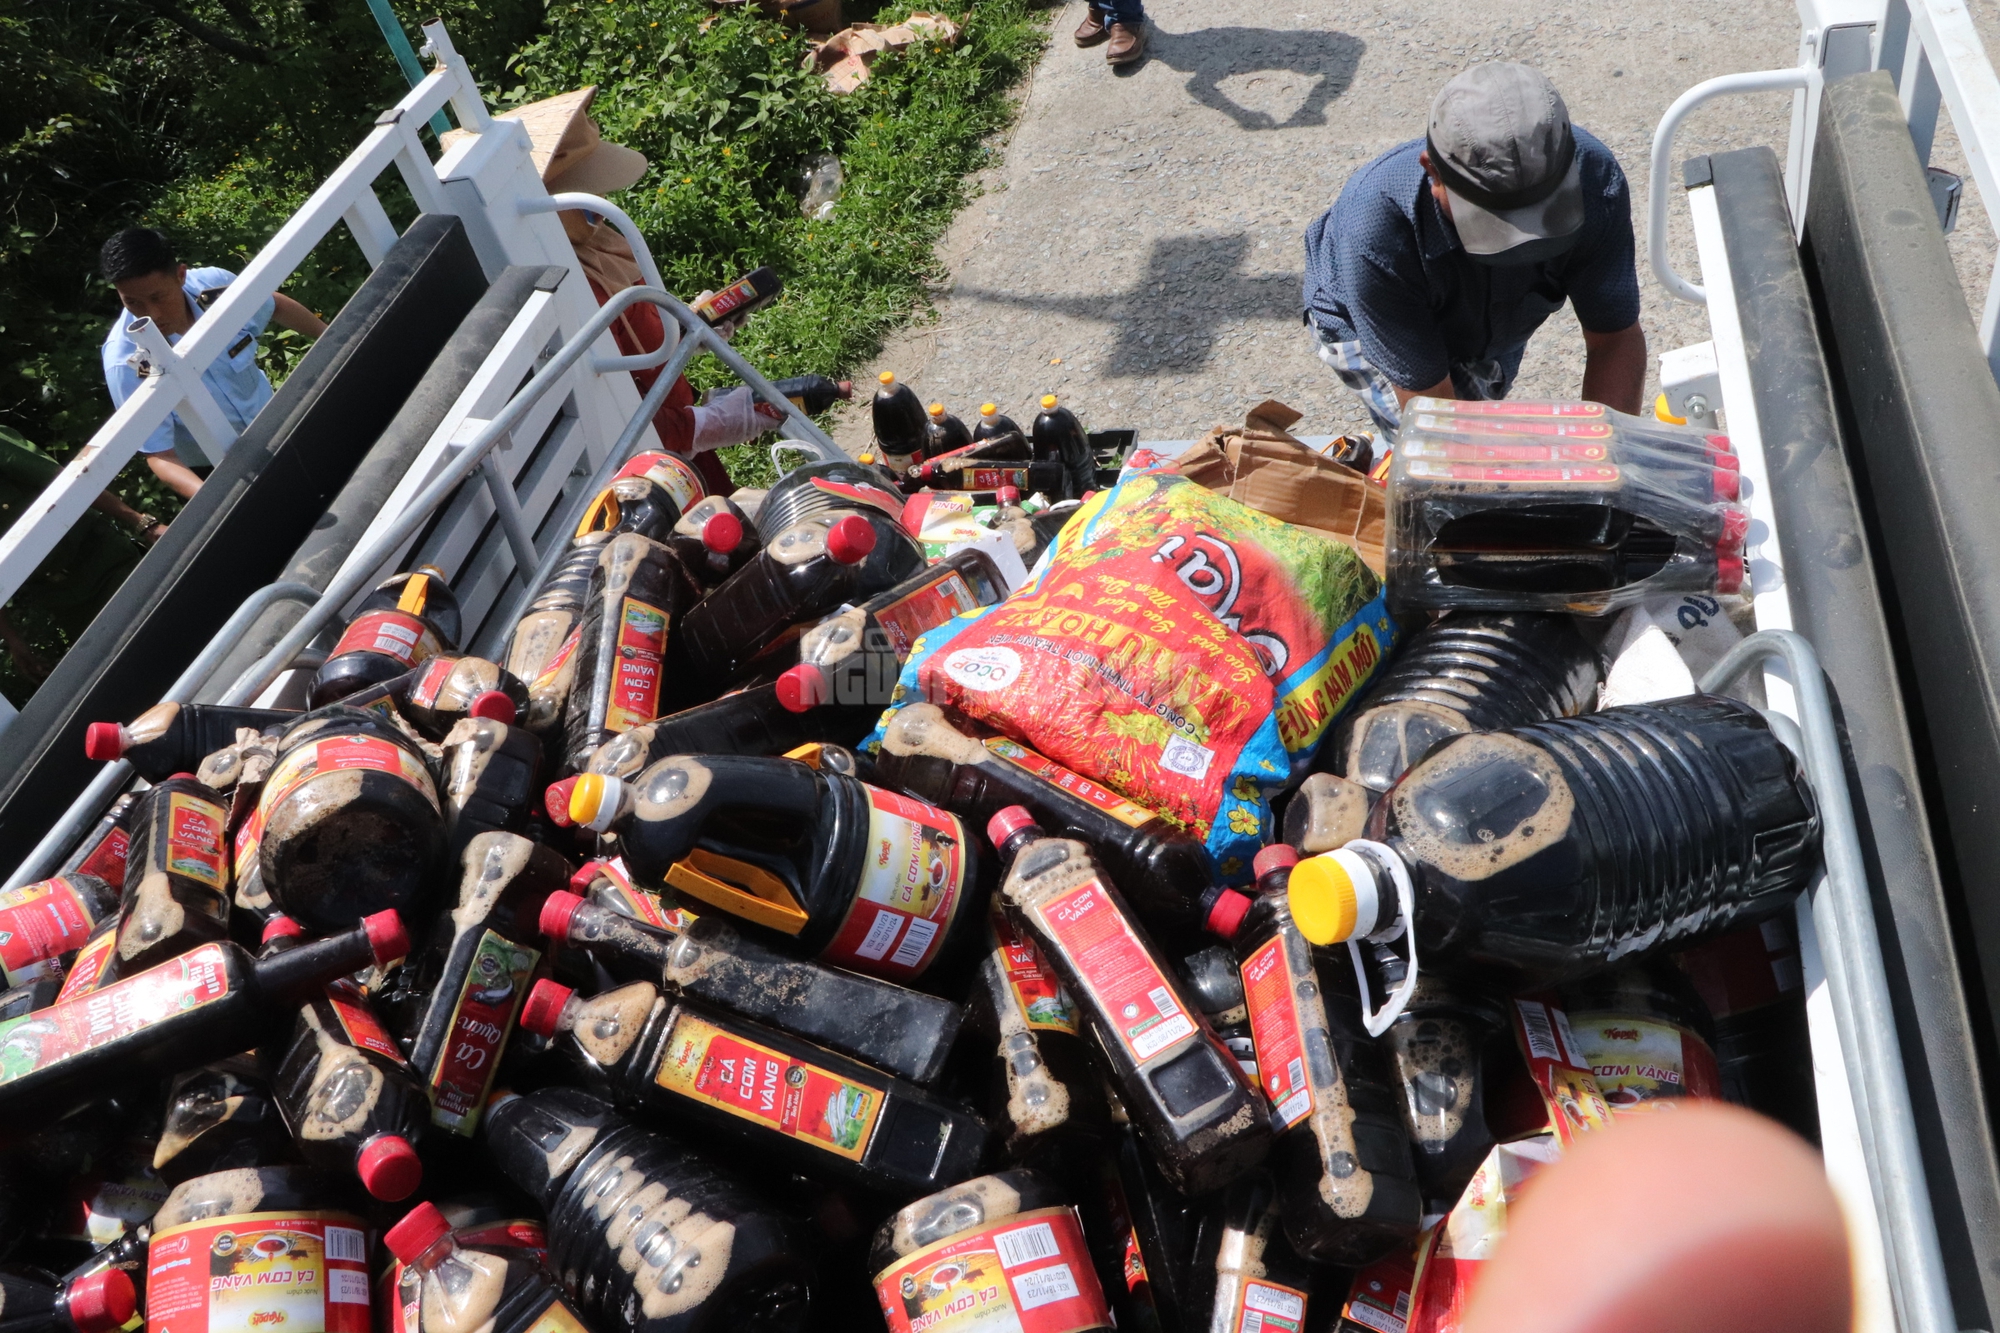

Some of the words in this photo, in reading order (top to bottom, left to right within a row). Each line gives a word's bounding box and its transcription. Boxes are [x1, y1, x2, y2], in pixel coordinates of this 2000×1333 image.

[1016, 634, 1061, 655] THÀNH
[622, 663, 655, 676] VÀNG
[1063, 649, 1096, 668] MỘT
[952, 659, 1006, 681] OCOP
[1096, 661, 1135, 695] TNHH
[1324, 658, 1353, 709] NĂM
[1348, 632, 1378, 679] MỚI
[1135, 690, 1155, 709] TY
[1155, 702, 1196, 735] CÔNG
[910, 822, 922, 853] VÀNG
[906, 854, 920, 884] CƠM
[901, 884, 915, 903] CÁ
[455, 1042, 486, 1069] Cá
[719, 1058, 736, 1084] CÁ
[739, 1057, 757, 1100] CƠM
[1592, 1065, 1630, 1077] CƠM
[1636, 1065, 1679, 1083] VÀNG
[760, 1060, 779, 1111] VÀNG
[211, 1274, 252, 1293] VÀNG
[257, 1270, 293, 1285] CƠM
[297, 1270, 315, 1285] CÁ
[944, 1294, 975, 1317] CƠM
[979, 1286, 999, 1303] CÁ
[912, 1309, 942, 1333] VÀNG
